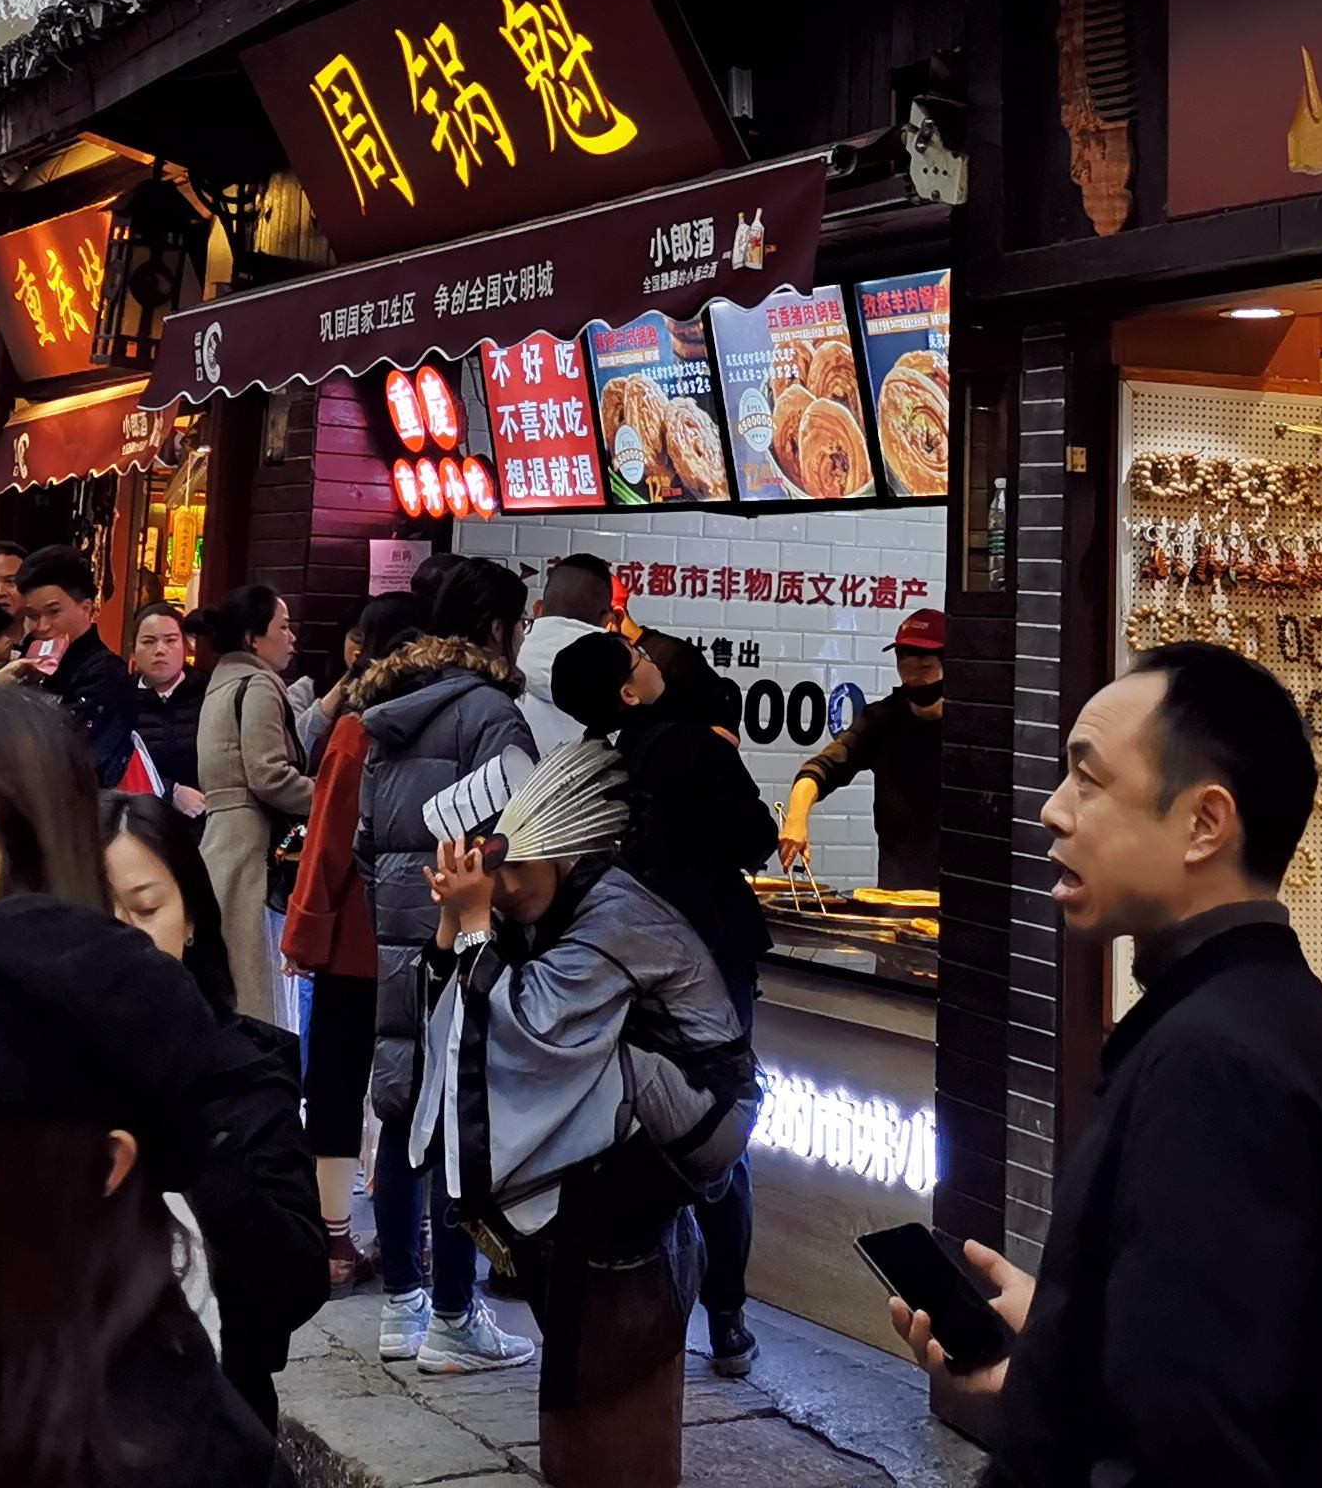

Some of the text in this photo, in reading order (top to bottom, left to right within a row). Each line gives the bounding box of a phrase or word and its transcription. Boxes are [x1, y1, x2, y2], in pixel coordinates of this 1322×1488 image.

[649, 216, 715, 268] 小郎酒
[320, 260, 554, 343] 巩固国家卫生区 争创全国文明城
[488, 343, 579, 388] 不好吃
[496, 395, 588, 444] 不喜欢吃
[504, 454, 597, 499] 想退就退
[548, 556, 928, 610] 成都市非物质文化遗产
